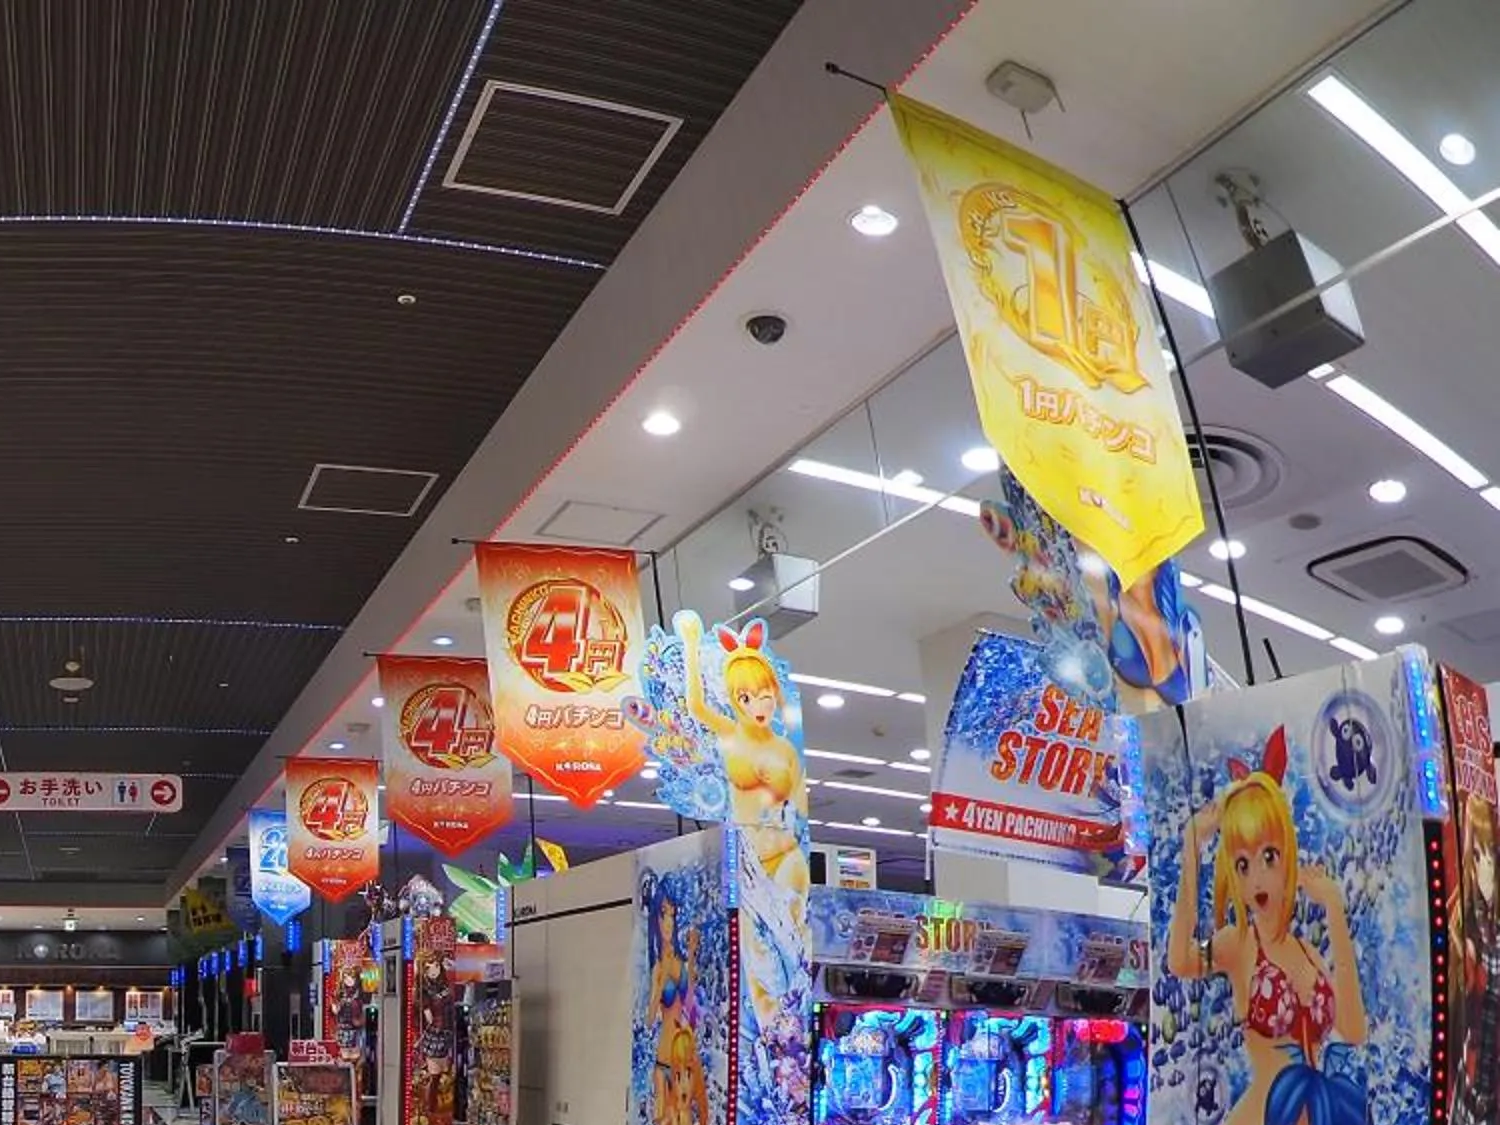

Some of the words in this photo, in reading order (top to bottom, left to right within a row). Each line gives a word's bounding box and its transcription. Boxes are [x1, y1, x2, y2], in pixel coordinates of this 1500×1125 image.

[525, 705, 626, 729] 4円パチンコ
[1034, 683, 1105, 743] SEA
[18, 777, 104, 797] お手洗い
[410, 777, 491, 797] 4円パチンコ
[41, 798, 80, 807] TOILET
[963, 800, 1004, 833] 4YEN
[1004, 810, 1078, 845] PACHINKO
